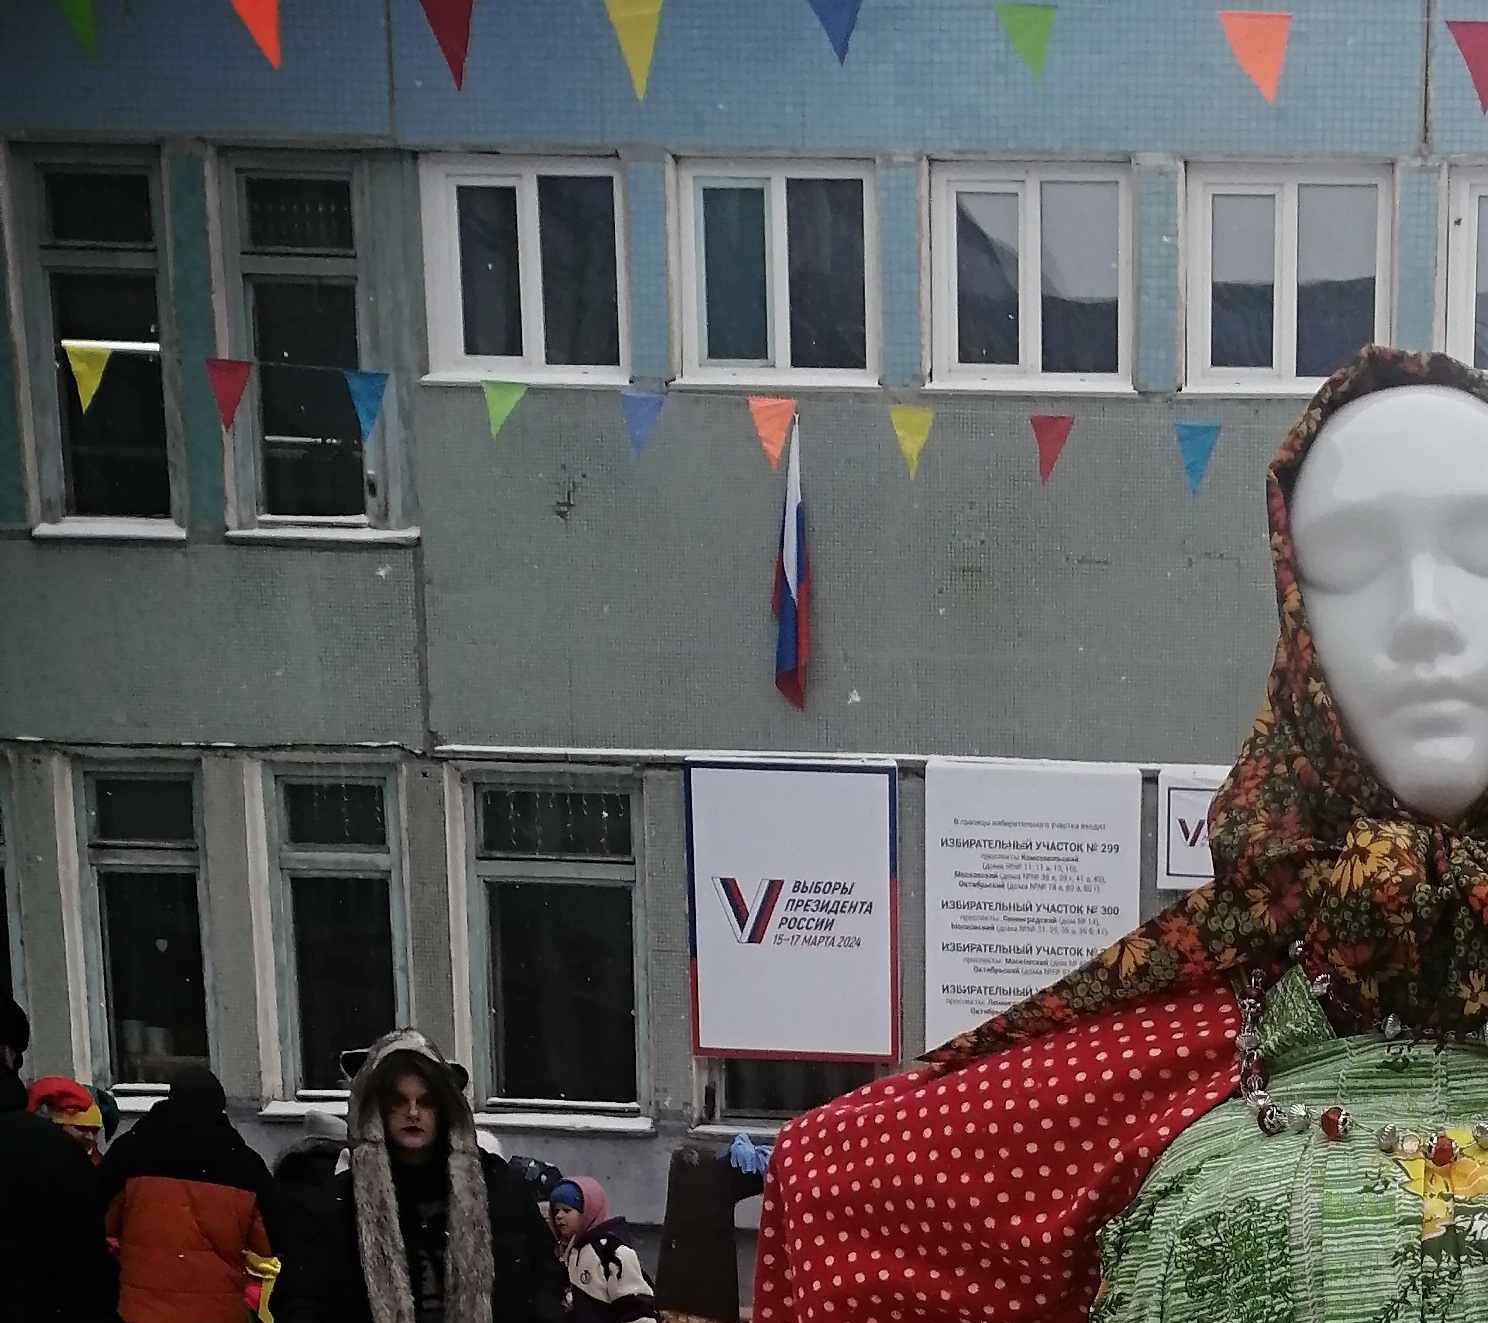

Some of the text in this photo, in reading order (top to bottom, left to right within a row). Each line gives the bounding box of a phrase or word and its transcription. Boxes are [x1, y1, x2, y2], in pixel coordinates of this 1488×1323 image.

[940, 837, 1033, 850] ИЗБИРАТЕЛЬНЫЙ
[1036, 840, 1083, 852] УЧАСТОК
[1100, 843, 1120, 853] 299
[791, 880, 856, 895] ВЫБОРЫ
[784, 898, 873, 915] ПРЕЗИДЕНТА
[941, 899, 1033, 912] ИЗБИРАТЕЛЬНЫЙ
[1036, 902, 1083, 915] УЧАСТОК
[1101, 905, 1120, 916] 300
[777, 916, 836, 931] РОССИИ
[801, 934, 836, 947] МАРТА
[836, 935, 862, 948] 2024
[941, 942, 1033, 955] ИЗБИРАТЕЛЬНЫЙ
[1036, 944, 1083, 957] УЧАСТОК
[941, 984, 1033, 997] ИЗБИРАТЕЛЬНЫЙ
